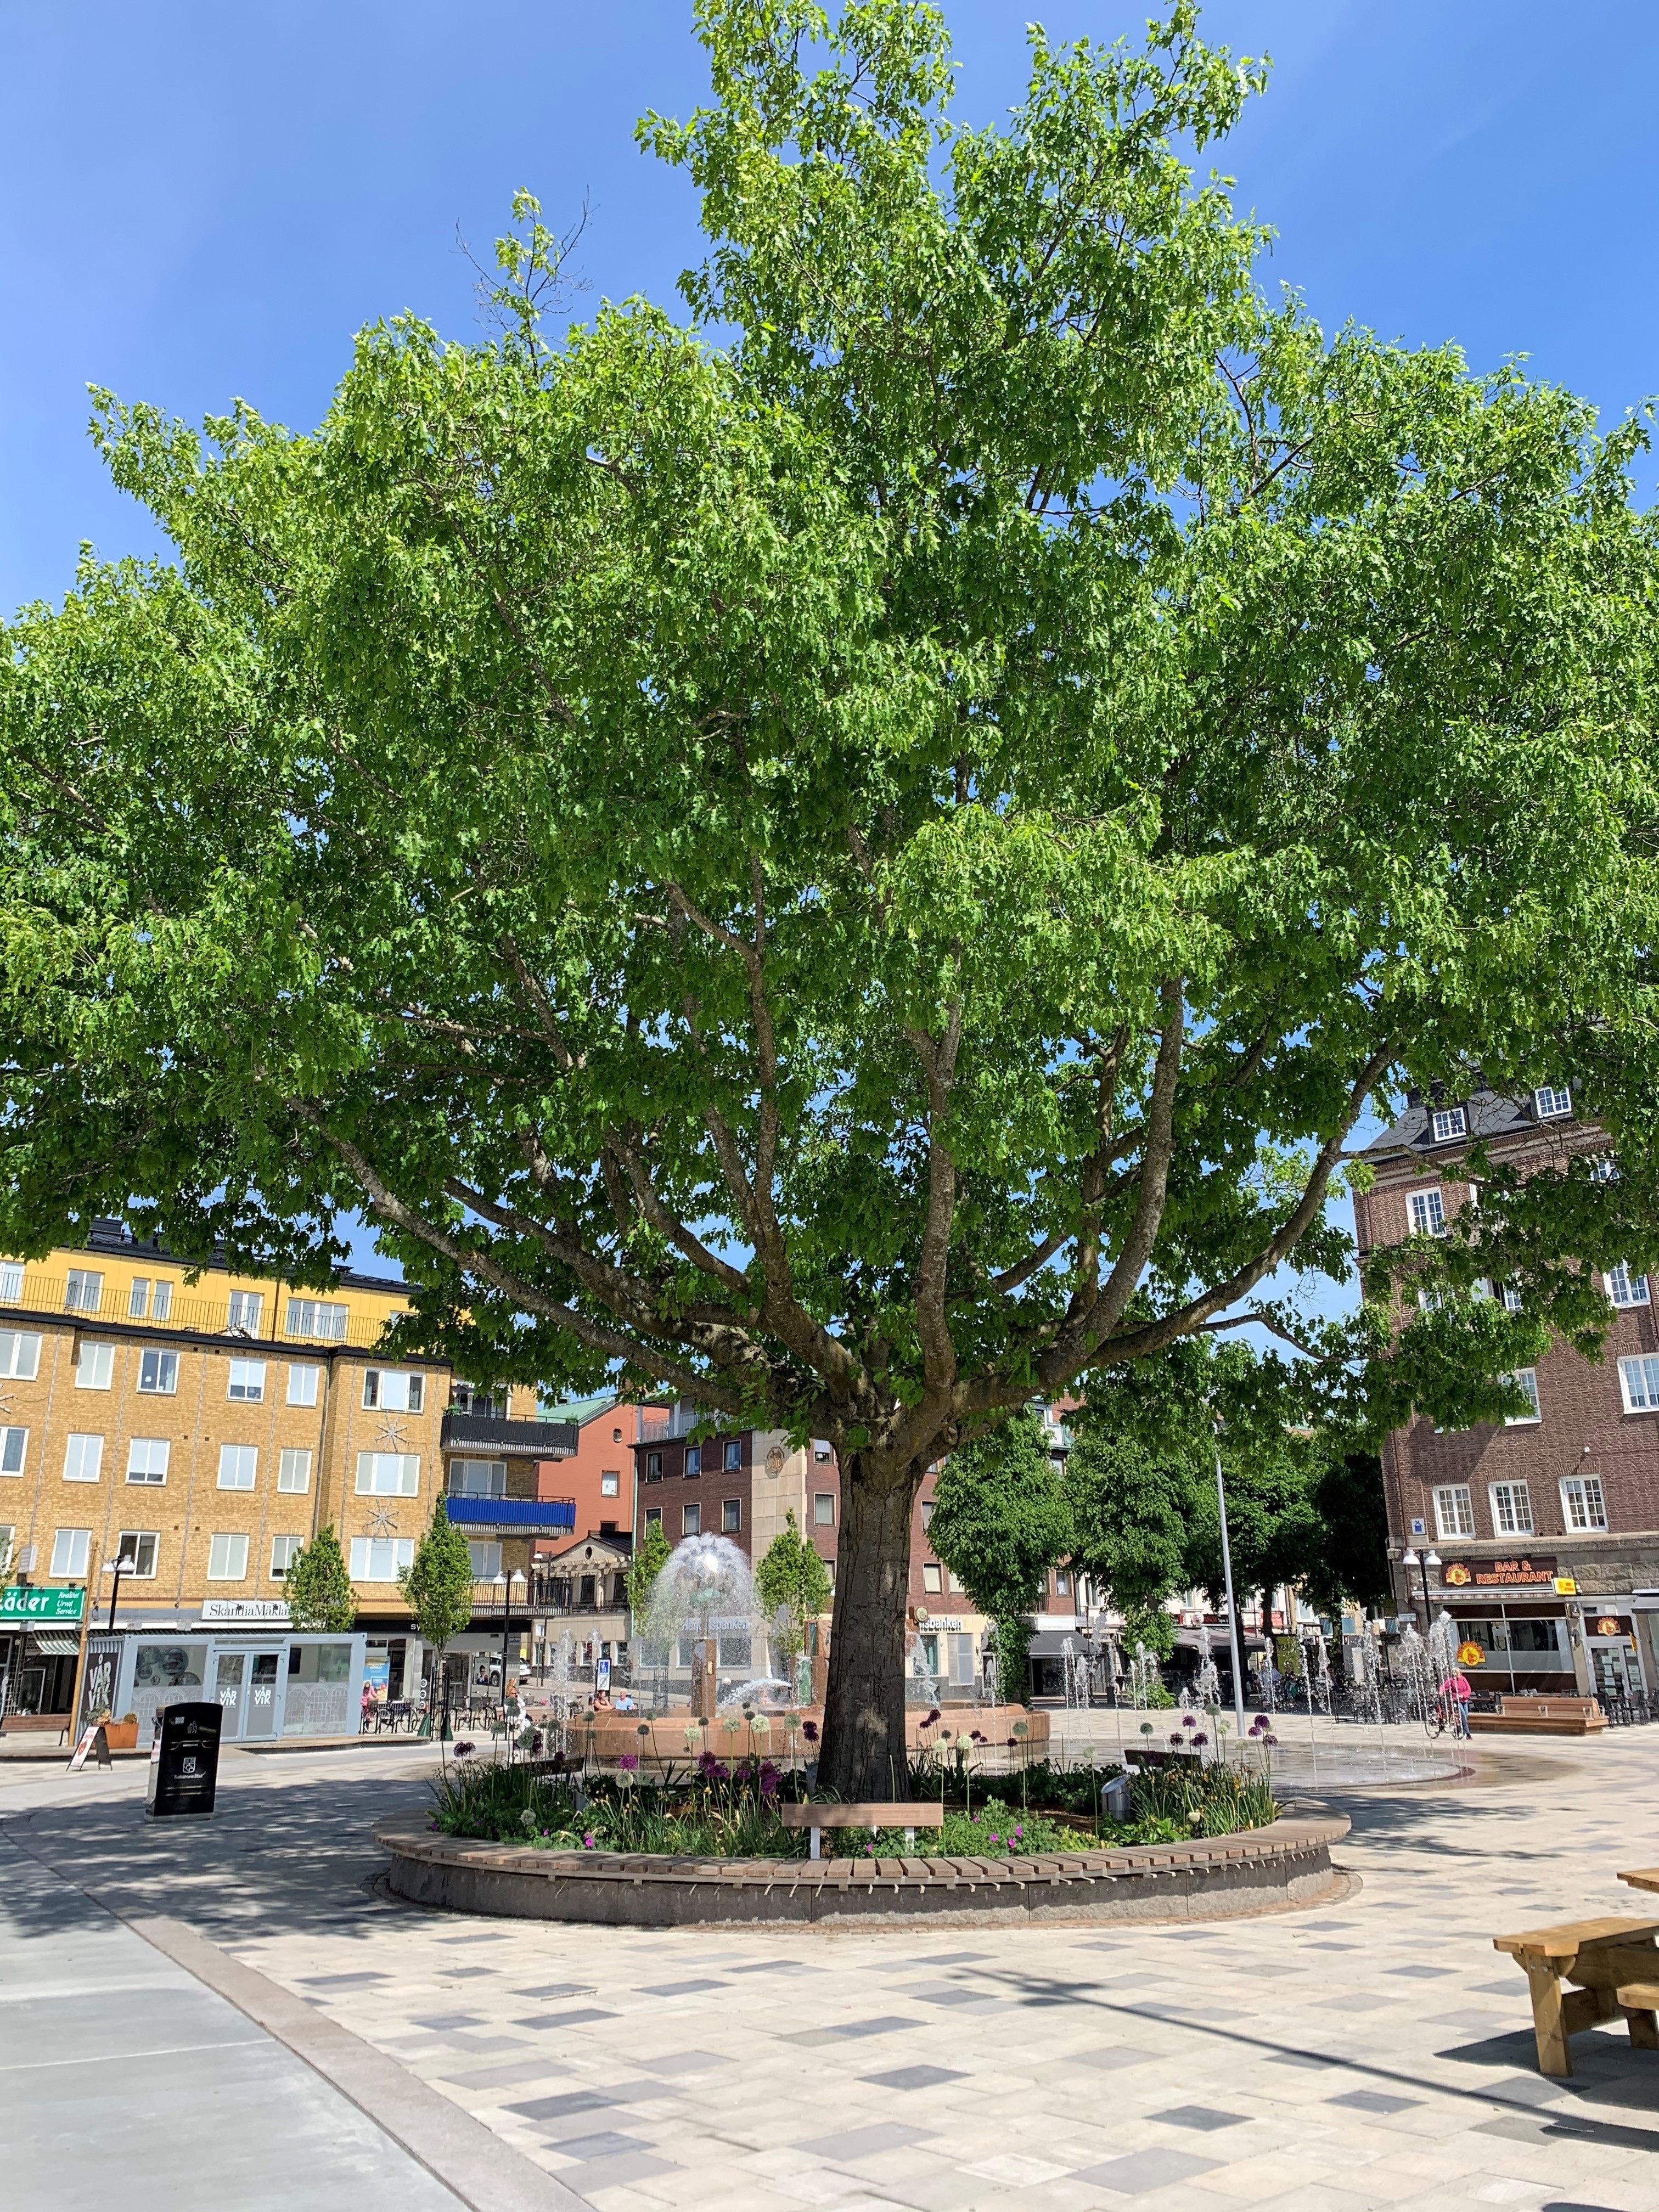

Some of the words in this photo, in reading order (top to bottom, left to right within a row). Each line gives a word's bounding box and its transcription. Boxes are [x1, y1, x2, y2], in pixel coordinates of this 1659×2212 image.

[1494, 1562, 1519, 1572] BAR
[1522, 1561, 1532, 1571] &
[1476, 1571, 1553, 1584] RESTAURANT
[89, 1654, 111, 1690] VÅR
[88, 1683, 111, 1711] VIK
[220, 1687, 237, 1698] VÅR
[255, 1686, 272, 1698] VÅR
